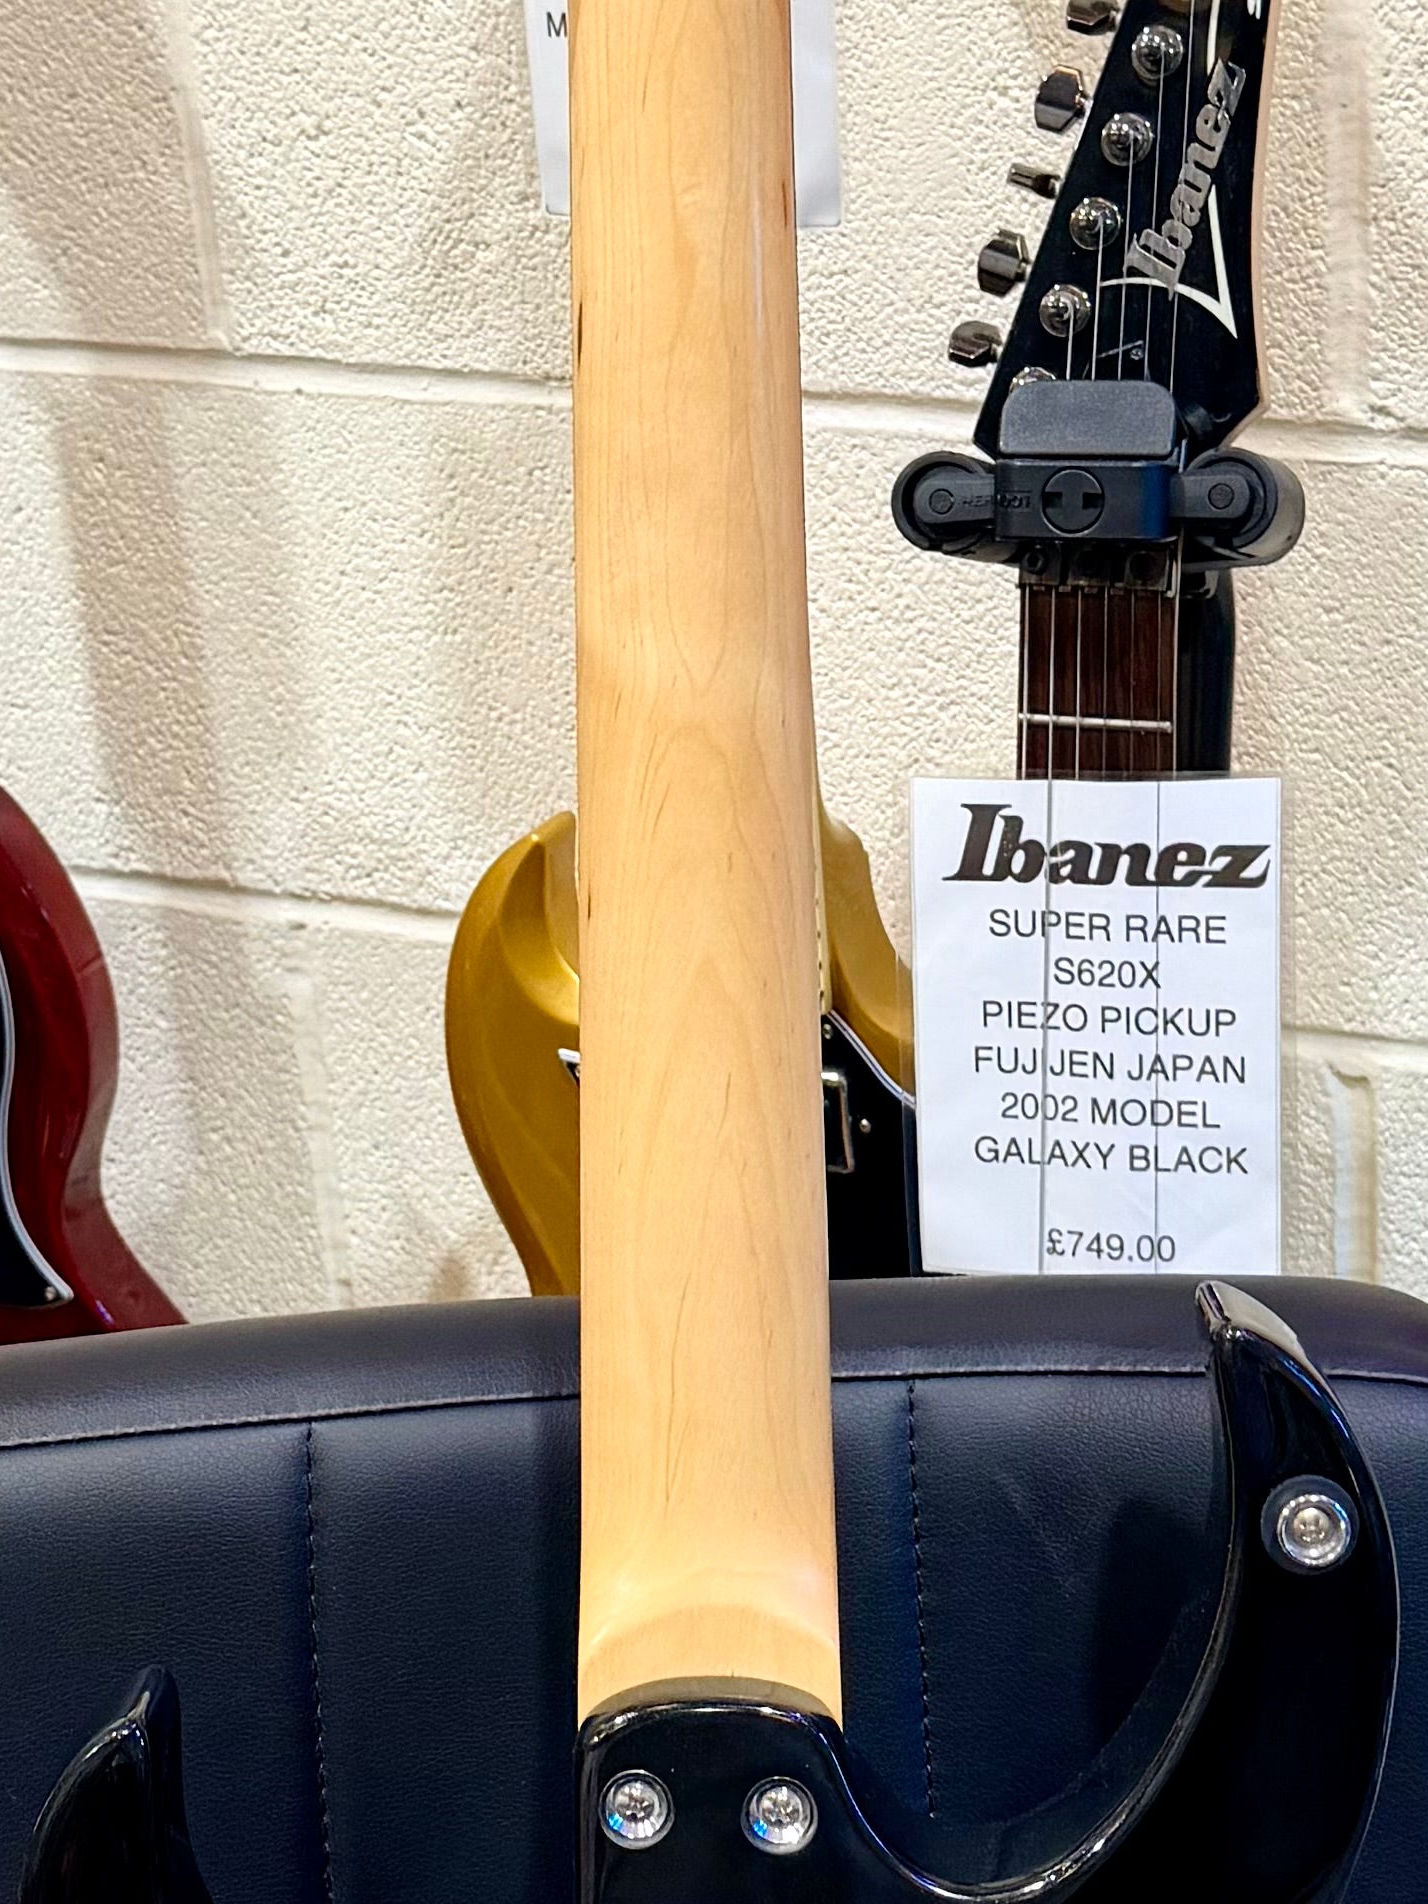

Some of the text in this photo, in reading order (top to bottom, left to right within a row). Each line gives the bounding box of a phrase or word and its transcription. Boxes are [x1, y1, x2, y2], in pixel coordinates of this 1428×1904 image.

[1122, 57, 1247, 301] Ibanez
[942, 803, 1272, 889] Ibanez
[989, 908, 1227, 945] SUPER RARE
[1052, 956, 1162, 989] S620X
[982, 1000, 1237, 1038] PIEZO PICKUP
[1126, 1053, 1247, 1085] JAPAN
[1000, 1091, 1221, 1130] 2002 MODEL
[974, 1135, 1249, 1175] GALAXY BLACK
[1045, 1227, 1176, 1263] £749.00
